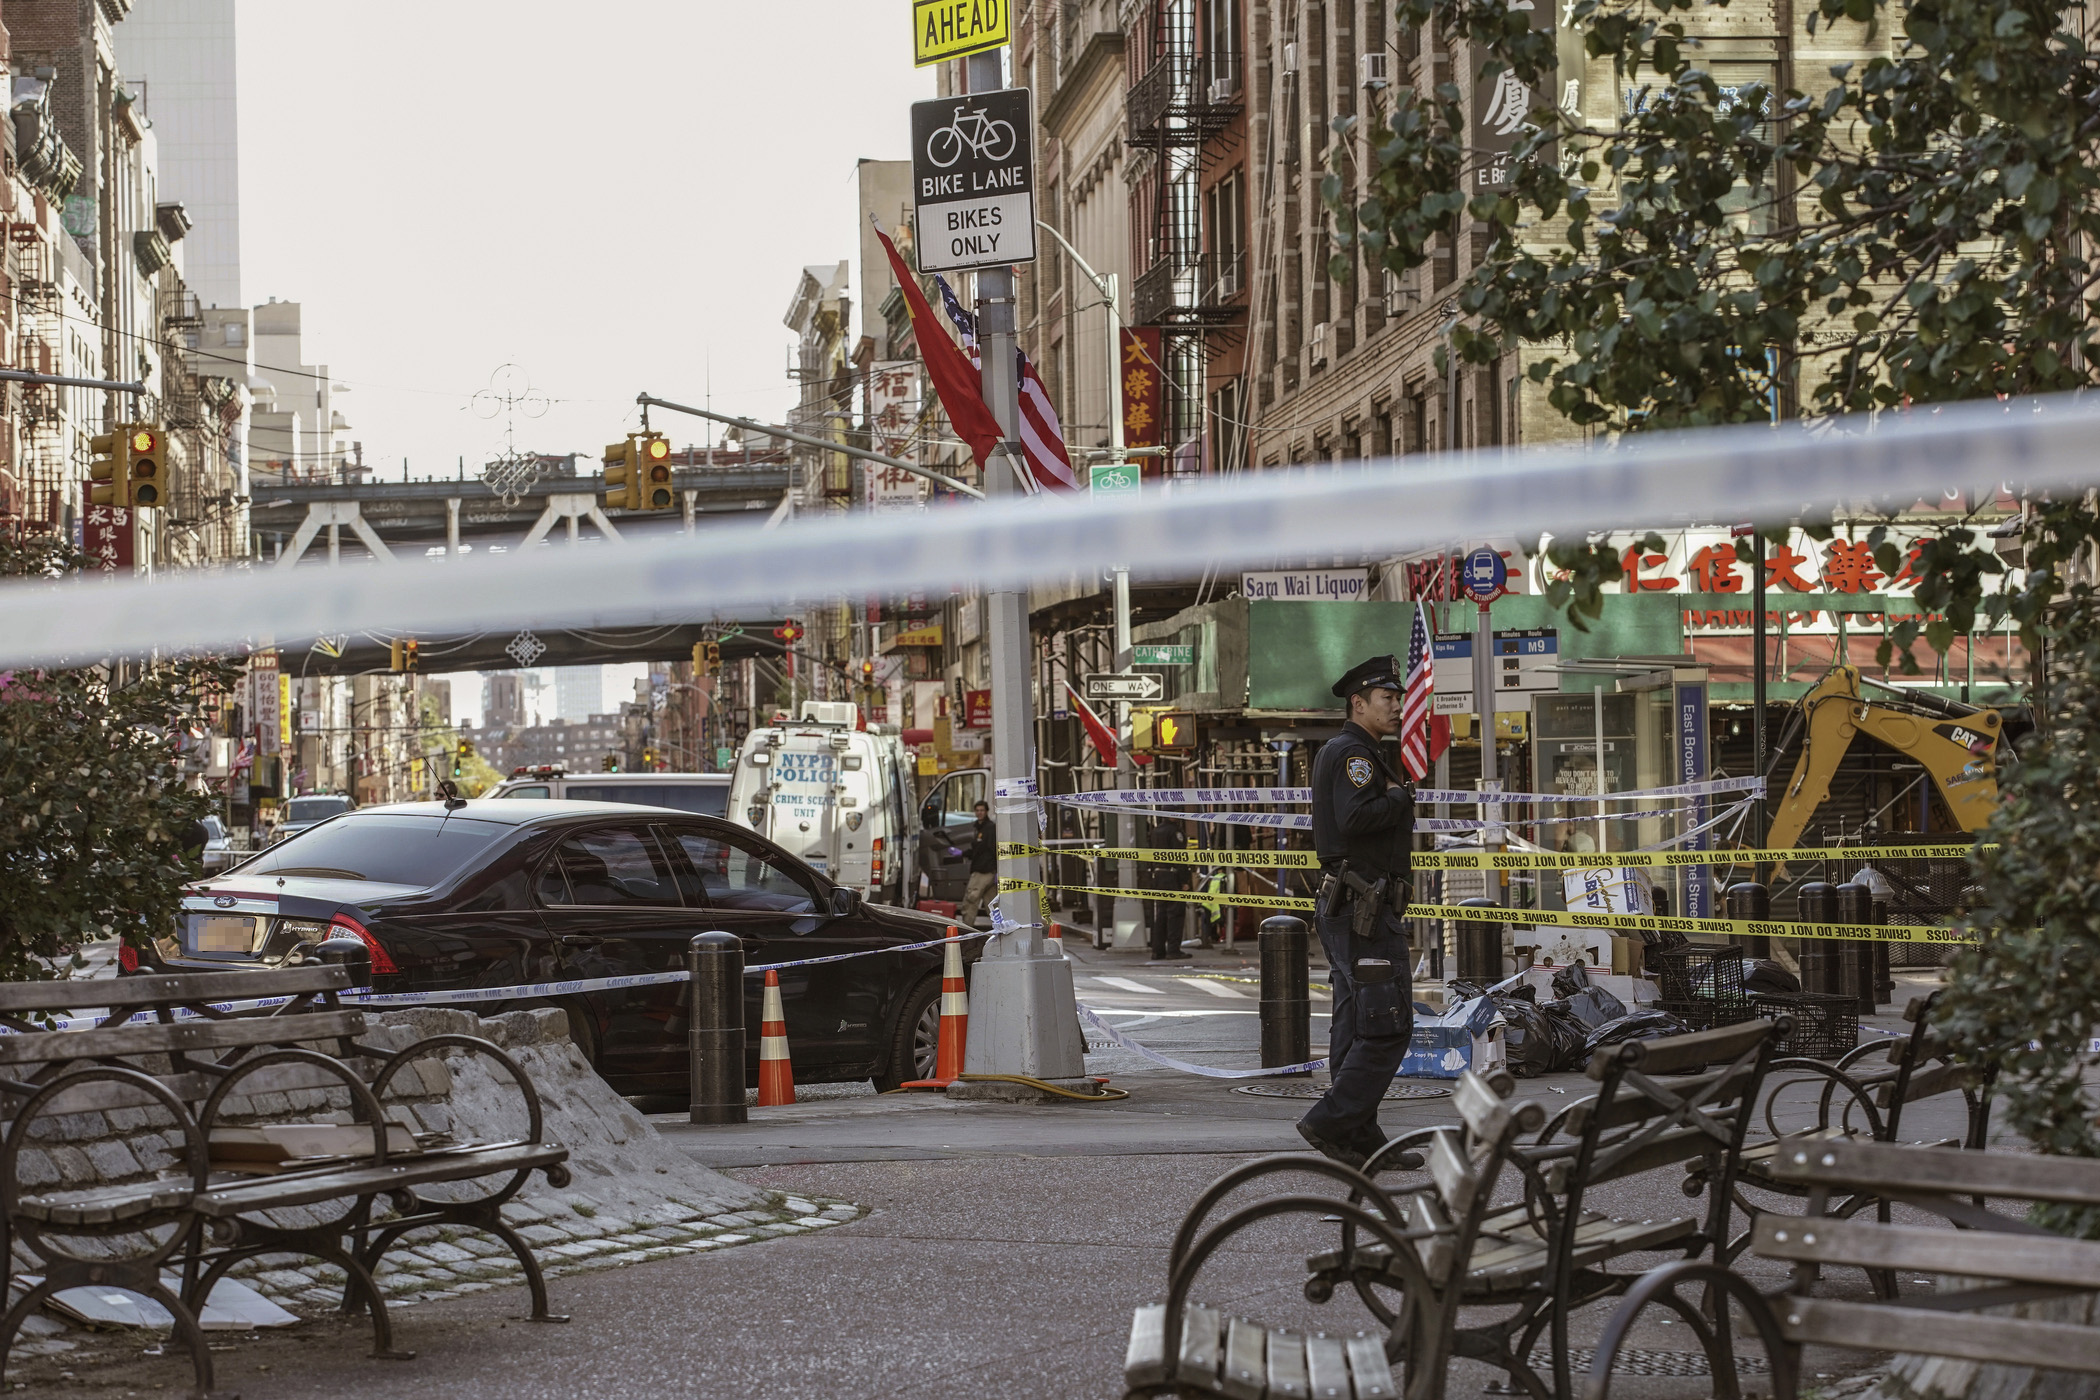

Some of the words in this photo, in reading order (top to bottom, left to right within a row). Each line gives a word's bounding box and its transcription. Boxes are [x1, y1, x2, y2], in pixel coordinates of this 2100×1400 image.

[925, 0, 998, 48] AHEAD
[922, 174, 964, 197] BIKE
[973, 166, 1024, 190] LANE
[948, 207, 1002, 231] BIKES
[951, 233, 1001, 257] ONLY
[1246, 577, 1278, 597] Sam
[1284, 575, 1310, 595] Wai
[1316, 574, 1364, 599] Liquor
[1465, 588, 1474, 597] NO
[1474, 588, 1501, 601] STANDING
[1135, 647, 1191, 657] CATHERINE
[1528, 640, 1545, 653] M9
[1092, 682, 1115, 692] ONE
[1128, 682, 1151, 692] WAY
[1441, 695, 1461, 703] Broadway
[1951, 727, 1978, 749] CAT
[782, 754, 833, 768] NYPD
[770, 768, 843, 783] POLICE
[775, 794, 804, 804] CRIME
[807, 795, 837, 806] SCENE
[1120, 792, 1137, 802] POLICE
[1137, 792, 1148, 802] LINE
[1153, 792, 1160, 801] DO
[1160, 791, 1170, 801] NOT
[1169, 791, 1185, 801] CROSS
[1197, 791, 1212, 801] POLICE
[1213, 791, 1223, 801] LINE
[1229, 790, 1236, 800] DO
[1236, 790, 1244, 800] NOT
[1244, 790, 1259, 800] CROSS
[1271, 790, 1285, 800] POLICE
[1286, 790, 1296, 800] LINE
[1301, 790, 1307, 800] DO
[1426, 792, 1435, 801] LINE
[1440, 792, 1446, 801] DO
[1445, 793, 1455, 801] NOT
[1454, 793, 1467, 802] CROSS
[1477, 794, 1491, 802] POLICE
[794, 808, 815, 817] UNIT
[1683, 704, 1695, 733] East
[1689, 883, 1699, 918] Stree
[1269, 815, 1284, 824] POLICE
[1153, 851, 1189, 862] CROSS
[1194, 852, 1214, 862] NOT
[1734, 852, 1750, 862] DO
[1753, 852, 1789, 861] SCENE
[1885, 849, 1908, 859] NOT
[1912, 848, 1927, 858] DO
[1930, 847, 1965, 857] SCENE
[1218, 853, 1233, 863] DO
[1236, 853, 1270, 865] SCENE
[1274, 853, 1307, 866] CRIME
[1411, 855, 1440, 867] SCEN
[1445, 855, 1478, 867] CRIME
[1493, 856, 1530, 867] CROSS
[1534, 856, 1556, 867] NOT
[1560, 856, 1575, 866] DO
[1578, 855, 1613, 866] SCENE
[1617, 855, 1652, 866] CRIME
[1666, 854, 1704, 864] CROSS
[1708, 853, 1731, 863] NOT
[1441, 908, 1462, 918] NOT
[1466, 909, 1481, 918] DO
[1484, 910, 1518, 921] SCENE
[1523, 912, 1557, 923] CRIME
[1572, 914, 1610, 925] CROSS
[1614, 917, 1636, 927] NOT
[1640, 918, 1655, 927] DO
[1658, 919, 1693, 930] SCENE
[1698, 921, 1733, 932] CRIME
[1748, 923, 1785, 935] CROSS
[1791, 925, 1813, 936] NOT
[1817, 926, 1832, 936] DO
[1836, 926, 1871, 938] SCENE
[1875, 928, 1911, 940] CRIME
[1303, 1060, 1325, 1072] CROSS
